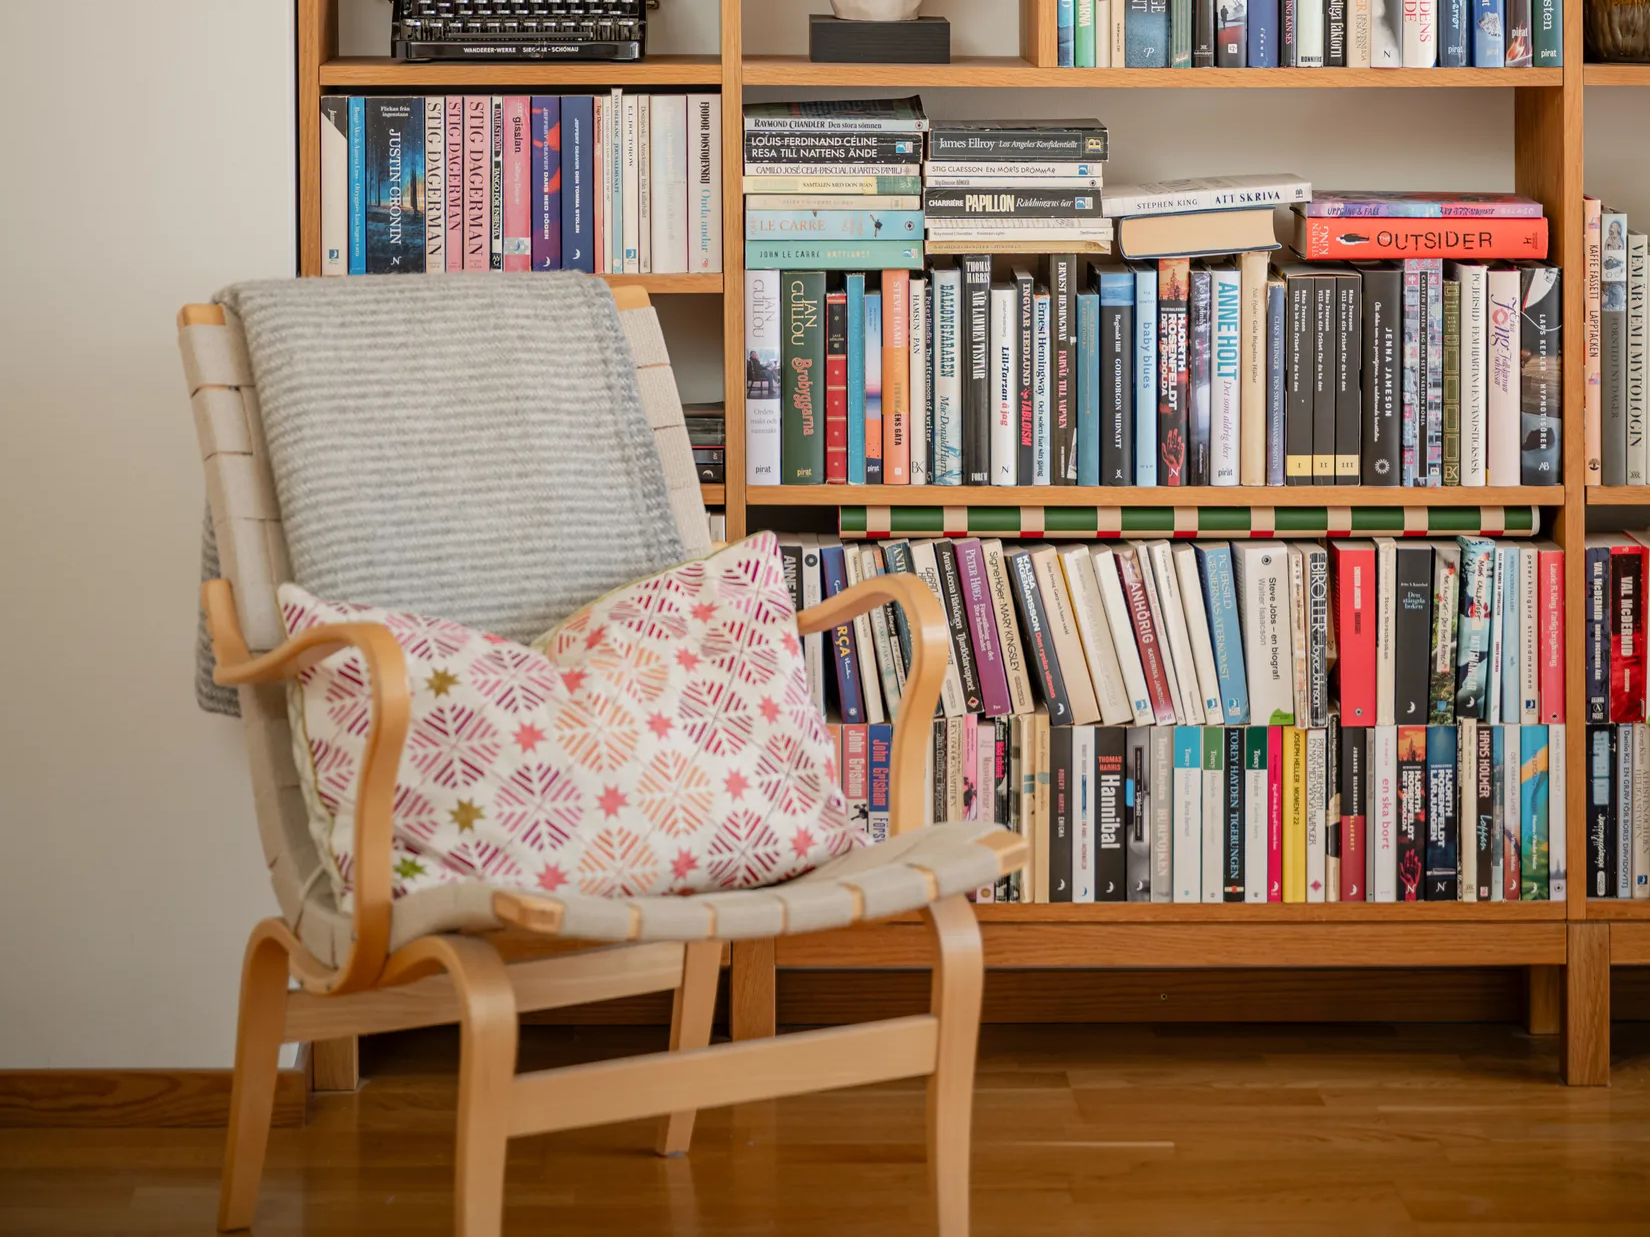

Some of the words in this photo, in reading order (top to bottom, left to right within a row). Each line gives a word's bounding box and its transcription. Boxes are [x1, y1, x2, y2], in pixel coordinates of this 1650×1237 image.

[1541, 49, 1557, 58] pirat
[469, 102, 484, 143] STIG
[389, 129, 401, 182] JUSTIN
[752, 136, 842, 146] LOUIS-FERDINAND
[844, 136, 877, 146] CÉLINE
[752, 149, 777, 157] RESA
[780, 149, 796, 157] TILL
[801, 149, 845, 157] NATTENS
[848, 148, 877, 157] ÄNDE
[939, 138, 966, 149] James
[968, 138, 995, 150] Ellroy
[390, 186, 401, 244] CRONIN
[469, 150, 484, 255] DAGERMAN
[966, 195, 1014, 212] PAPILLON
[1136, 200, 1176, 210] STEPHEN
[1179, 198, 1198, 207] KING
[1215, 195, 1236, 206] ATT
[1240, 191, 1280, 204] SKRIVA
[1377, 231, 1492, 249] OUTSIDER
[1631, 244, 1644, 280] VEM
[1218, 282, 1238, 332] ANNE
[1631, 284, 1646, 304] ÄR
[791, 280, 804, 345] GUILLOU
[803, 299, 817, 327] JAN
[1631, 306, 1643, 338] VEM
[940, 285, 954, 377] BALLONGFARAREN
[1141, 322, 1152, 352] baby
[1143, 356, 1153, 388] blues
[1217, 336, 1238, 380] HOLT
[792, 358, 814, 435] Brobyggarna
[1629, 351, 1642, 447] MYTOLOGIN
[1269, 578, 1277, 601] Steve
[1621, 576, 1633, 596] VAL
[1129, 582, 1154, 643] ANHÖRIG
[1621, 599, 1634, 656] McDERMID
[1271, 634, 1278, 645] en
[1271, 647, 1279, 680] biografi
[873, 740, 888, 762] John
[1230, 730, 1238, 763] TOREY
[873, 768, 888, 806] Grisham
[1230, 766, 1238, 808] HAYDEN
[1382, 779, 1389, 793] en
[1101, 775, 1120, 848] Hannibal
[1294, 817, 1299, 825] 22
[1382, 797, 1391, 817] ska
[1231, 812, 1239, 879] TIGERUNGEN
[1382, 821, 1391, 849] bort
